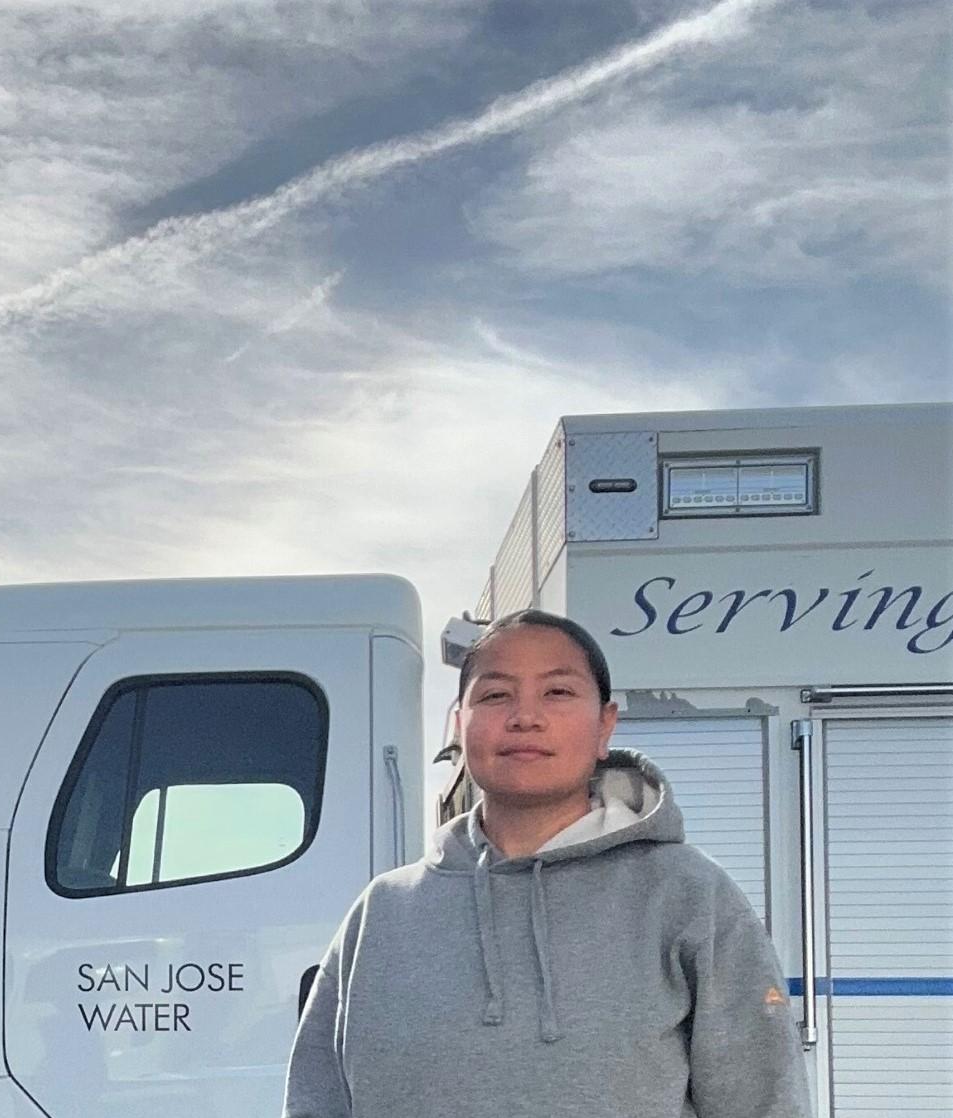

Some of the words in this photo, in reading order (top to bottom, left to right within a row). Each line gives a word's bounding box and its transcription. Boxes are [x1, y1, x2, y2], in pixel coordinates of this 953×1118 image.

[610, 568, 953, 654] Serving
[77, 963, 149, 992] SAN
[161, 963, 244, 993] JOSE
[77, 1003, 192, 1032] WATER
